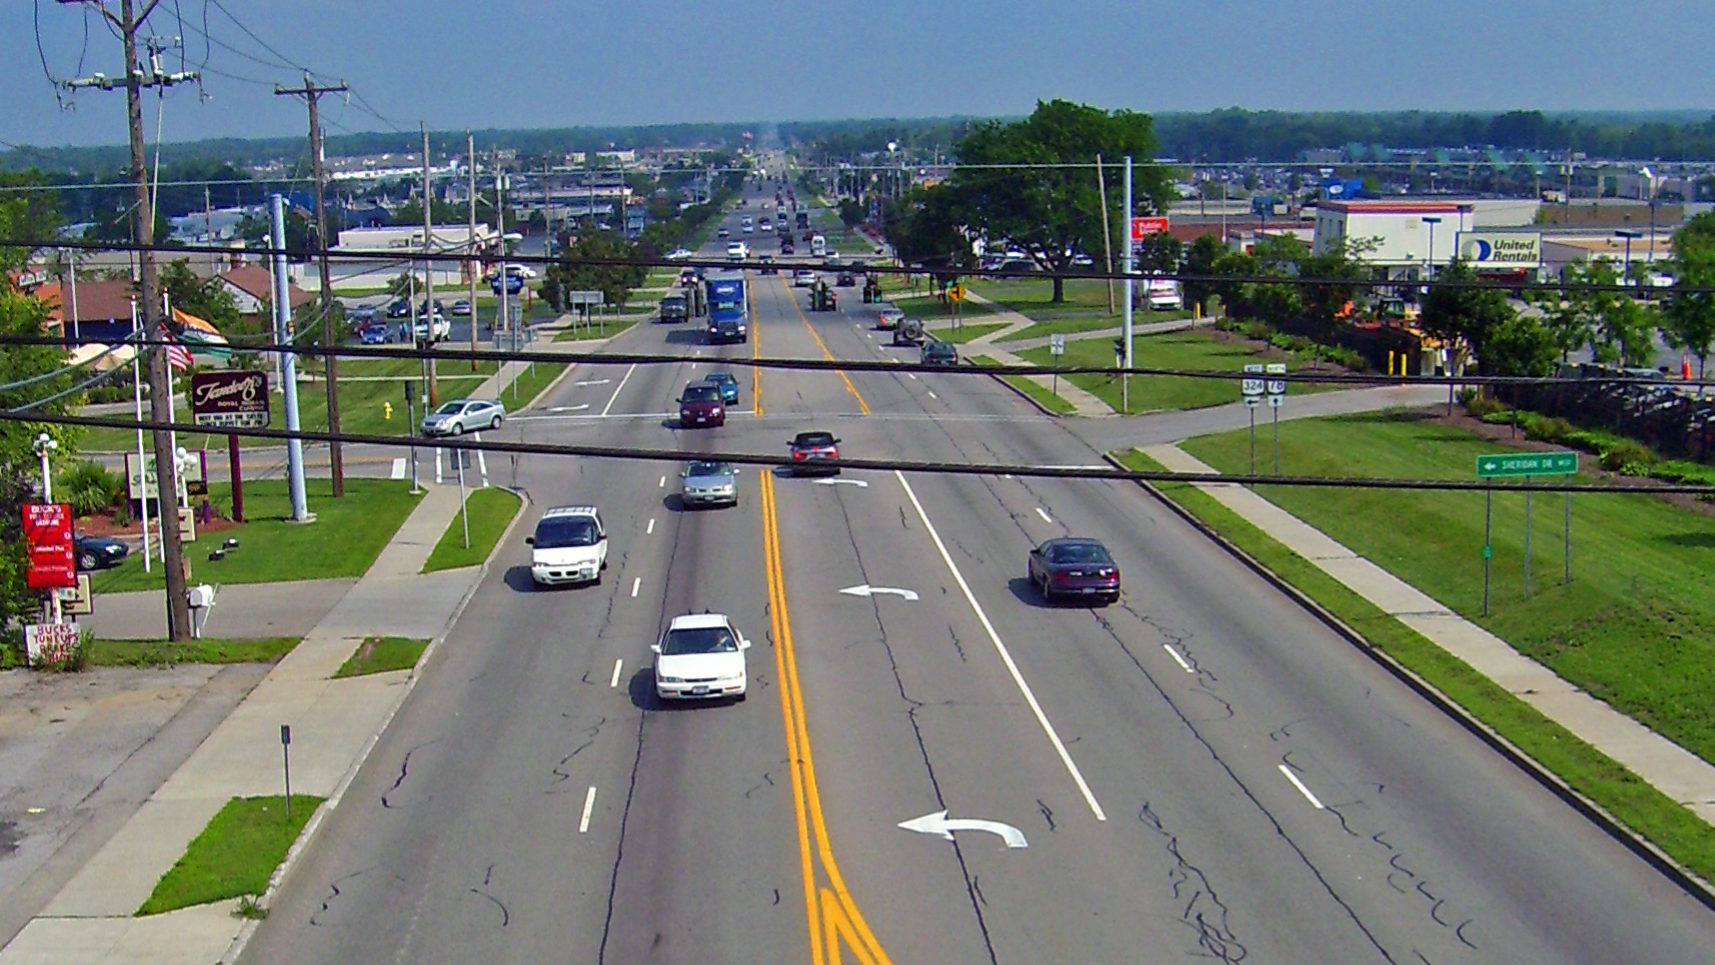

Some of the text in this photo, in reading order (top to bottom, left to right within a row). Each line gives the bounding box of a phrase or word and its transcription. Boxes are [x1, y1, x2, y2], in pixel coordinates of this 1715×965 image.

[1494, 240, 1535, 250] United
[1493, 251, 1538, 262] Rentals
[1244, 381, 1263, 391] 324
[1270, 380, 1284, 390] 78
[1542, 459, 1553, 468] DR
